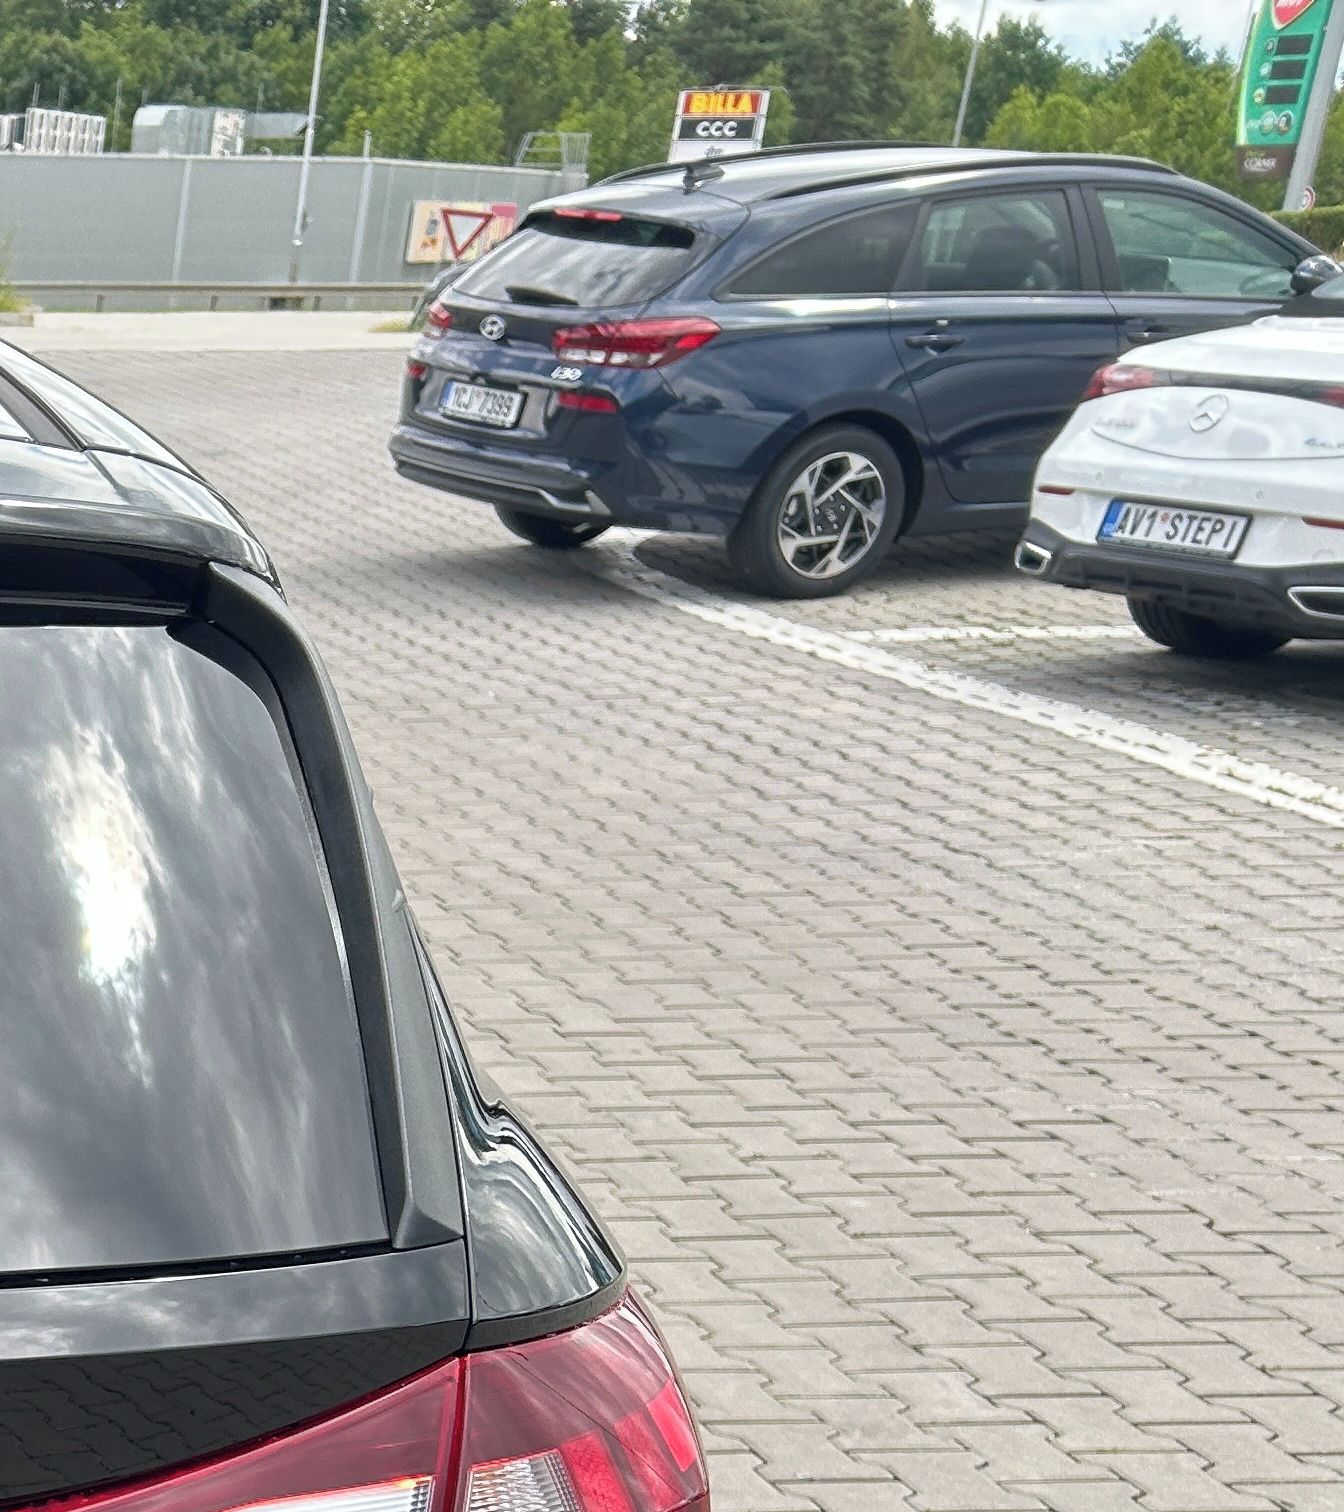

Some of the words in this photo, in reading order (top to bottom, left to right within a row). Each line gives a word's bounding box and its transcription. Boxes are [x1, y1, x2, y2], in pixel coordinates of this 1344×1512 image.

[689, 92, 752, 113] BILLA
[696, 120, 737, 137] CCC
[1115, 506, 1159, 538] AV1
